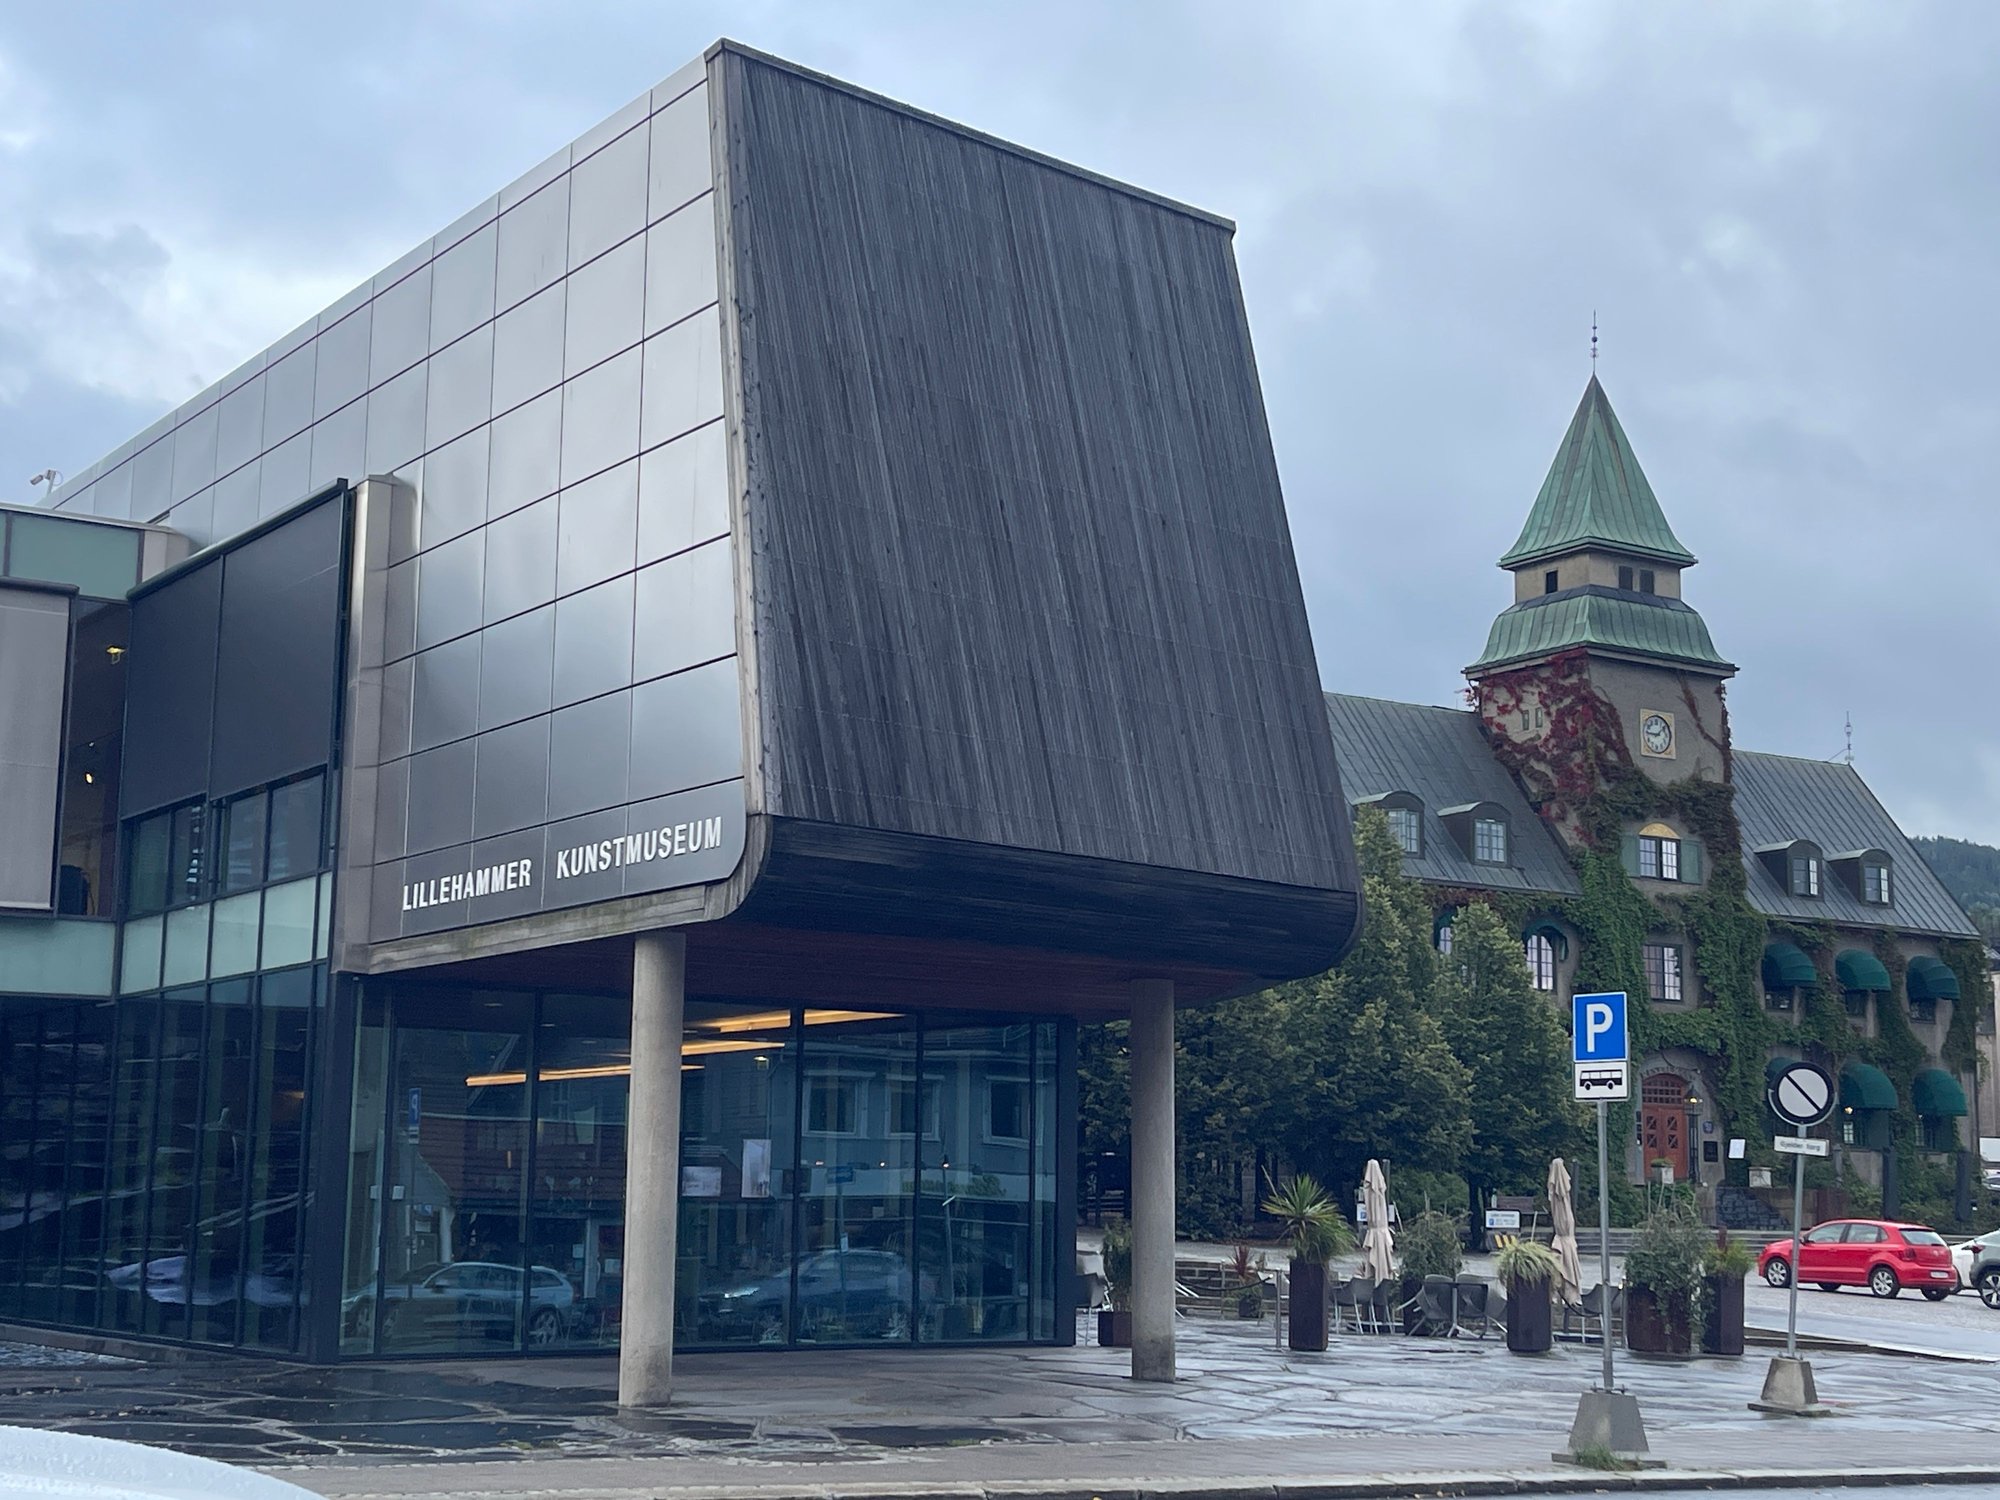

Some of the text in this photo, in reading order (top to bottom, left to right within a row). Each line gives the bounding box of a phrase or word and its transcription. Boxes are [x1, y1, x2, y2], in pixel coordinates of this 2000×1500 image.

[402, 815, 722, 911] LILLEHAMMER KUNSTMUSEUM
[1586, 1003, 1614, 1053] P
